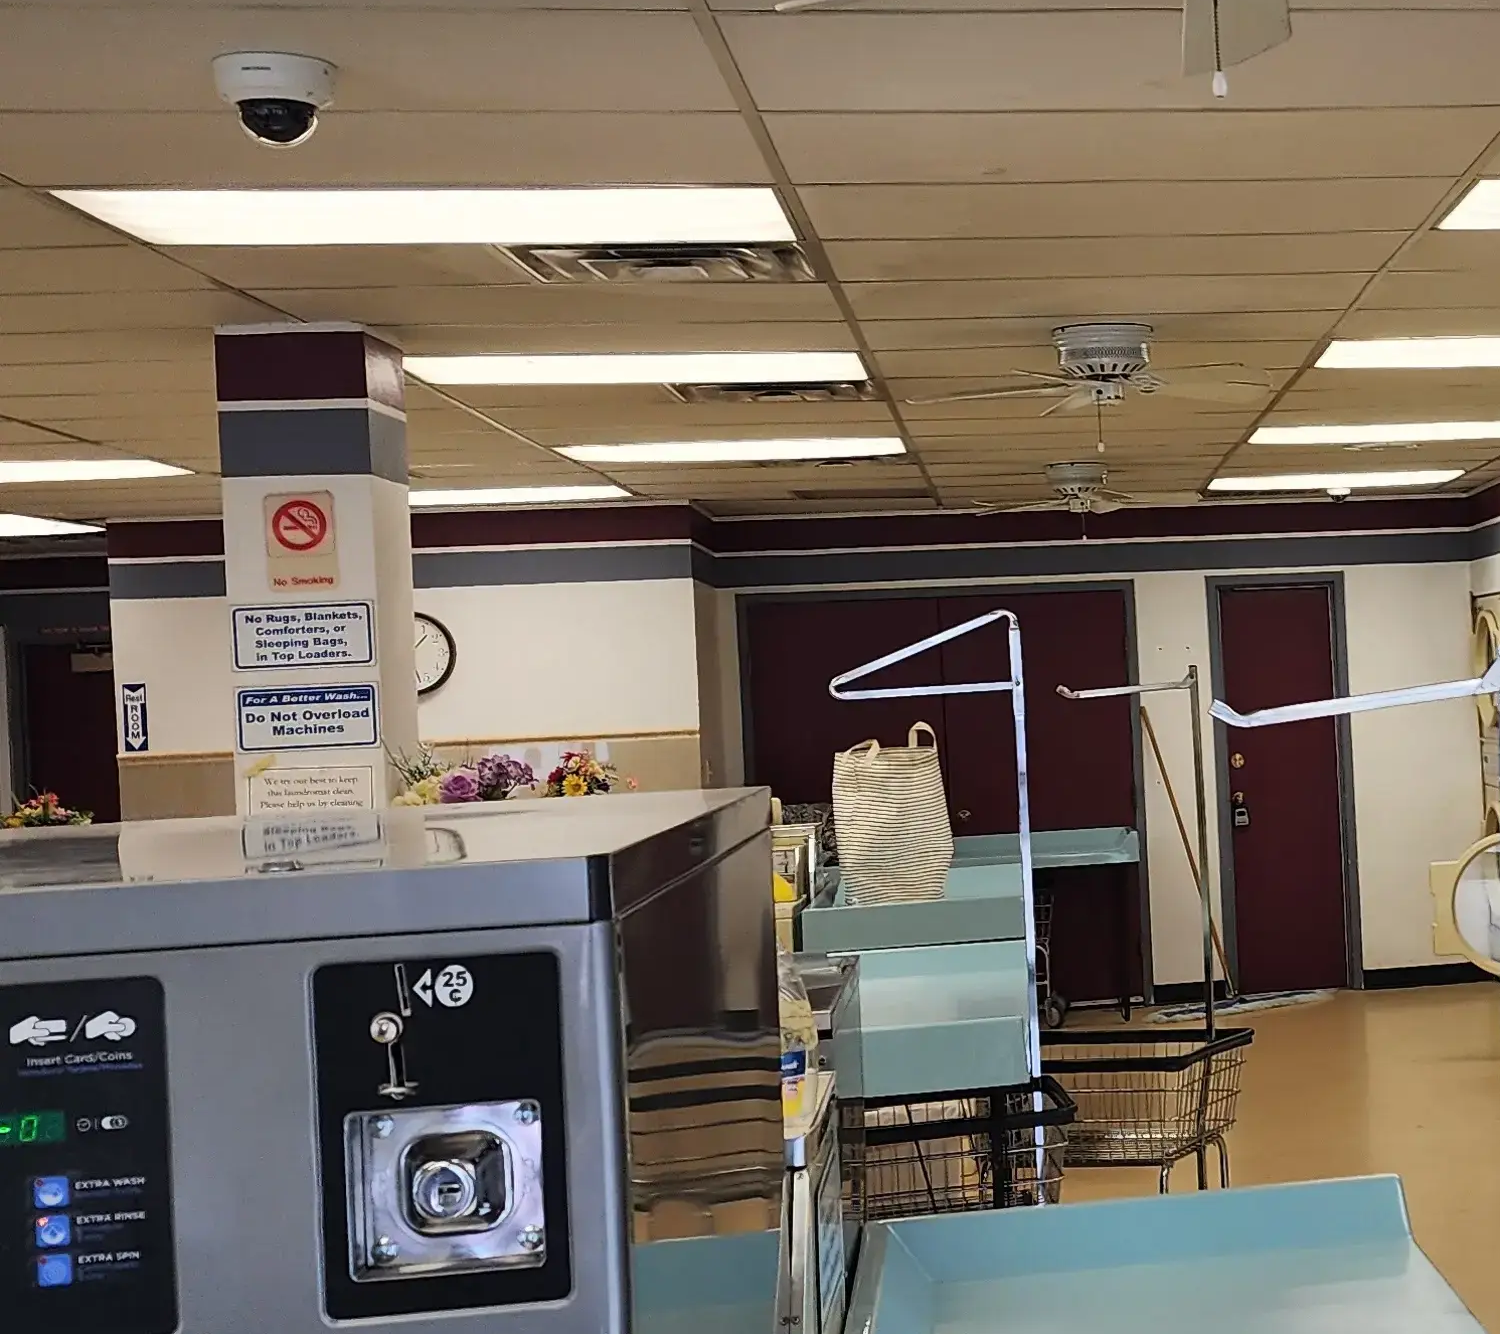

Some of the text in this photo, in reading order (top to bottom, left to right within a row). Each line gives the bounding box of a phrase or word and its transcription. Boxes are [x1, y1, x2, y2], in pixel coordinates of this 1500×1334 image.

[274, 575, 334, 586] No Smoking
[245, 611, 363, 624] No Rugs, Blankets,
[256, 625, 346, 636] Comforters, or
[255, 637, 348, 649] Sleeping Bags,
[256, 650, 353, 662] in Top Loaders.
[125, 694, 143, 703] Rest
[245, 696, 265, 705] For
[269, 695, 278, 703] A
[282, 693, 321, 703] Better
[245, 708, 369, 724] Do Not Overload
[272, 723, 344, 736] Machines
[339, 775, 358, 785] keep
[287, 800, 305, 810] help
[442, 971, 468, 988] 25
[27, 1055, 61, 1067] Insert
[75, 1176, 145, 1190] EXTRA WASH
[76, 1211, 146, 1225] EXTRA RINSE
[78, 1251, 140, 1264] EXTRA SPIN
